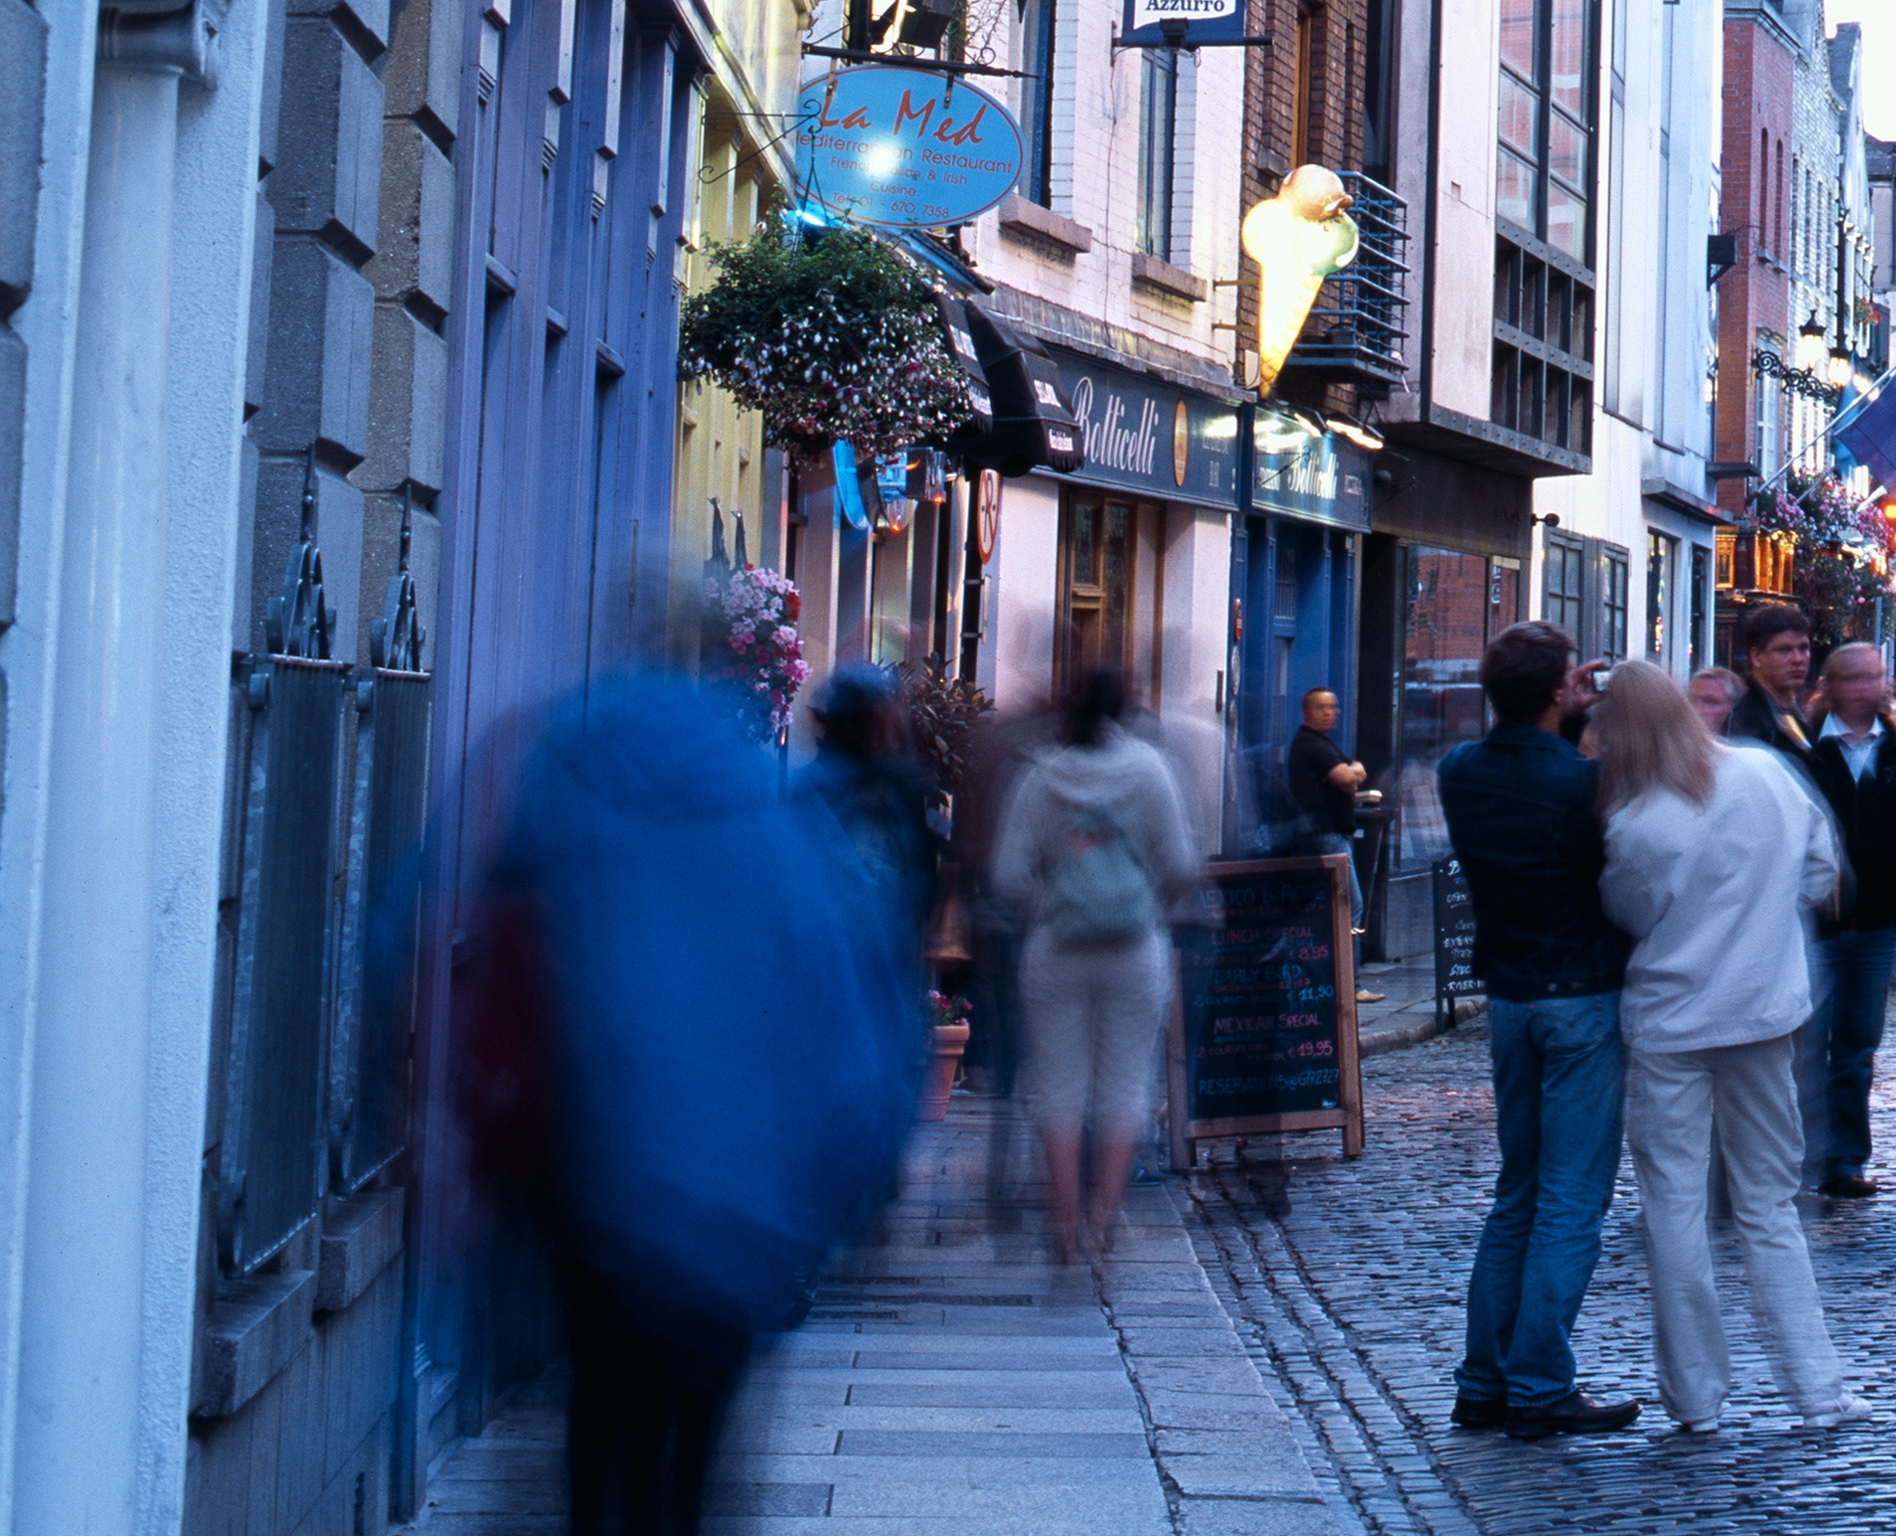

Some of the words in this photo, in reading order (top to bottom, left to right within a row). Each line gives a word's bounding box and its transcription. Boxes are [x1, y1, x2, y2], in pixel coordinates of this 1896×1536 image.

[820, 80, 872, 130] La
[893, 89, 988, 147] Med
[796, 131, 914, 160] editerraan
[927, 170, 937, 182] &
[943, 172, 967, 186] Irish
[891, 201, 915, 214] 670
[921, 204, 950, 219] 7358
[1071, 376, 1159, 475] Botticelli
[1279, 1012, 1323, 1029] SPECIAL
